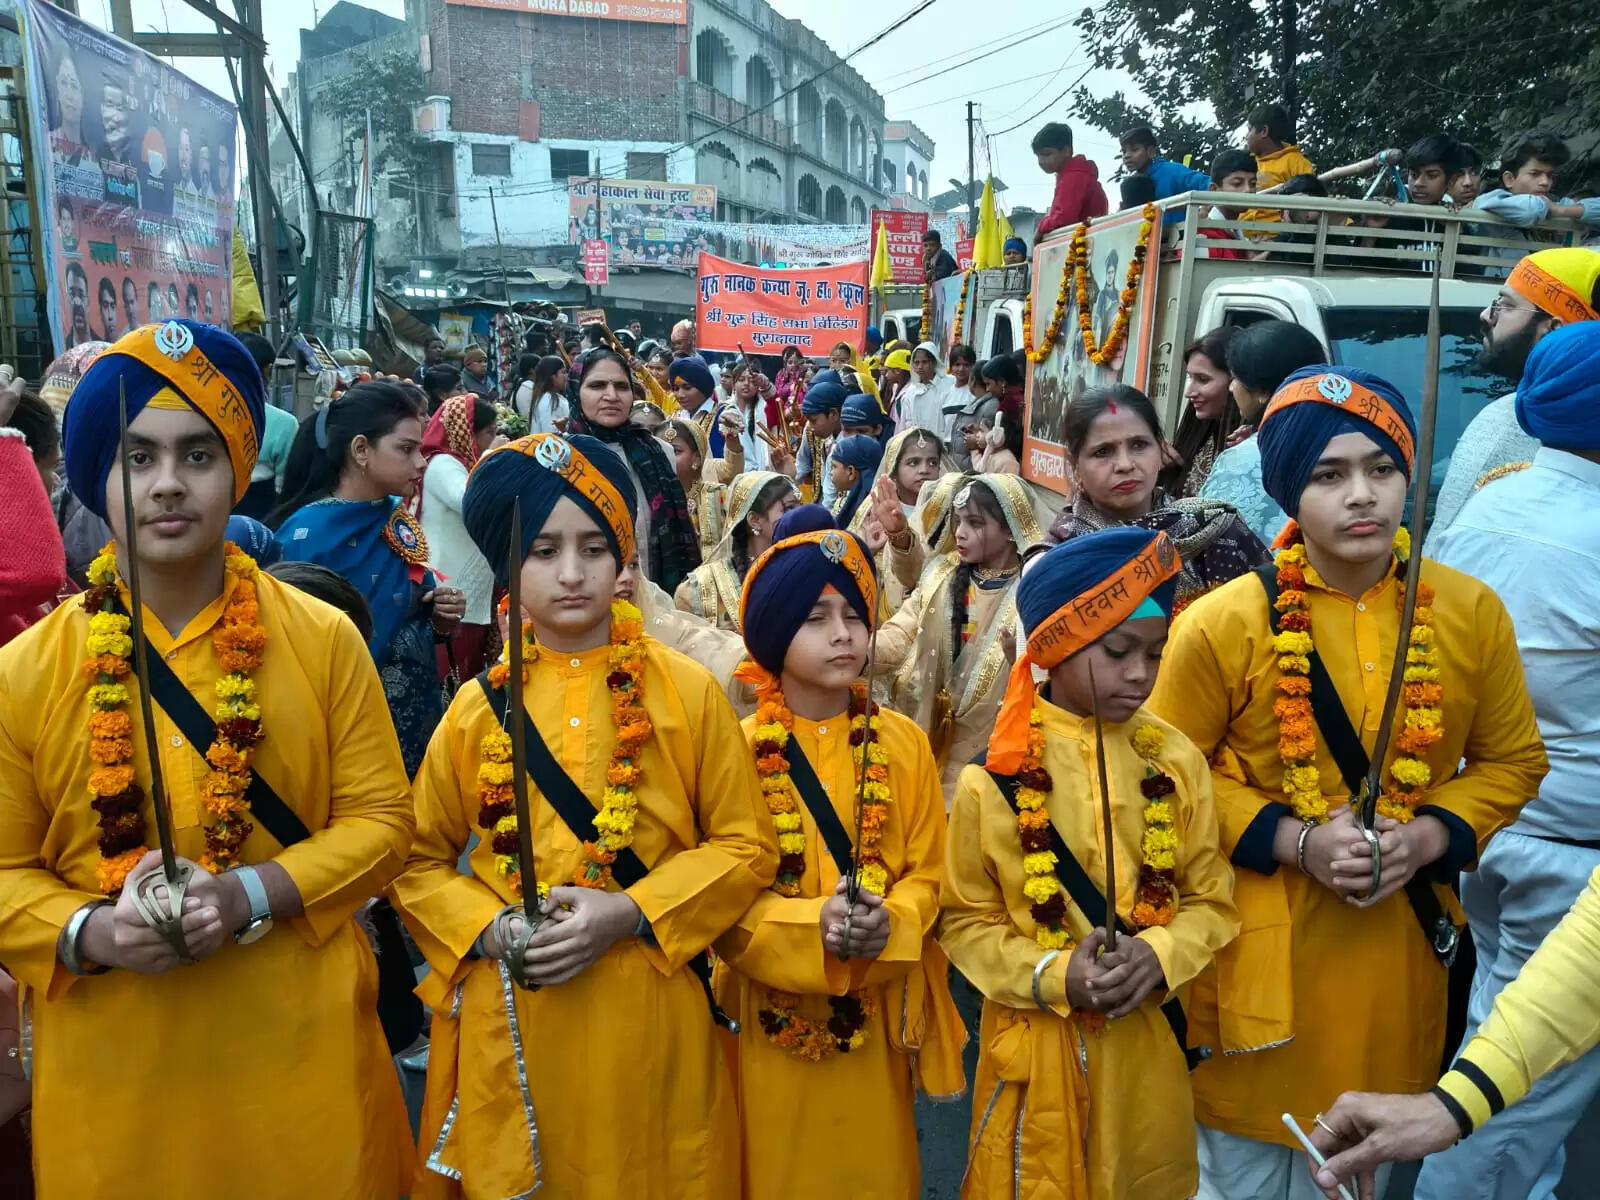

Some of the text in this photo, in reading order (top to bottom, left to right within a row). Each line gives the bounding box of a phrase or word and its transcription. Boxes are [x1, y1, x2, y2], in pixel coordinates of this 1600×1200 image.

[591, 184, 638, 199] महाकाल
[644, 183, 665, 200] सेवा
[670, 190, 690, 203] ट्रस्ट
[724, 274, 757, 293] नानक
[760, 278, 790, 297] कन्या
[836, 281, 865, 310] स्कूल
[705, 307, 721, 324] श्री
[751, 311, 779, 329] सिंह
[782, 316, 809, 329] सभा
[813, 315, 859, 330] बिल्डिंग
[751, 331, 813, 347] मुरादाबाद
[1358, 394, 1383, 424] श्री
[1072, 576, 1130, 627] दिवस
[1133, 553, 1159, 584] श्री
